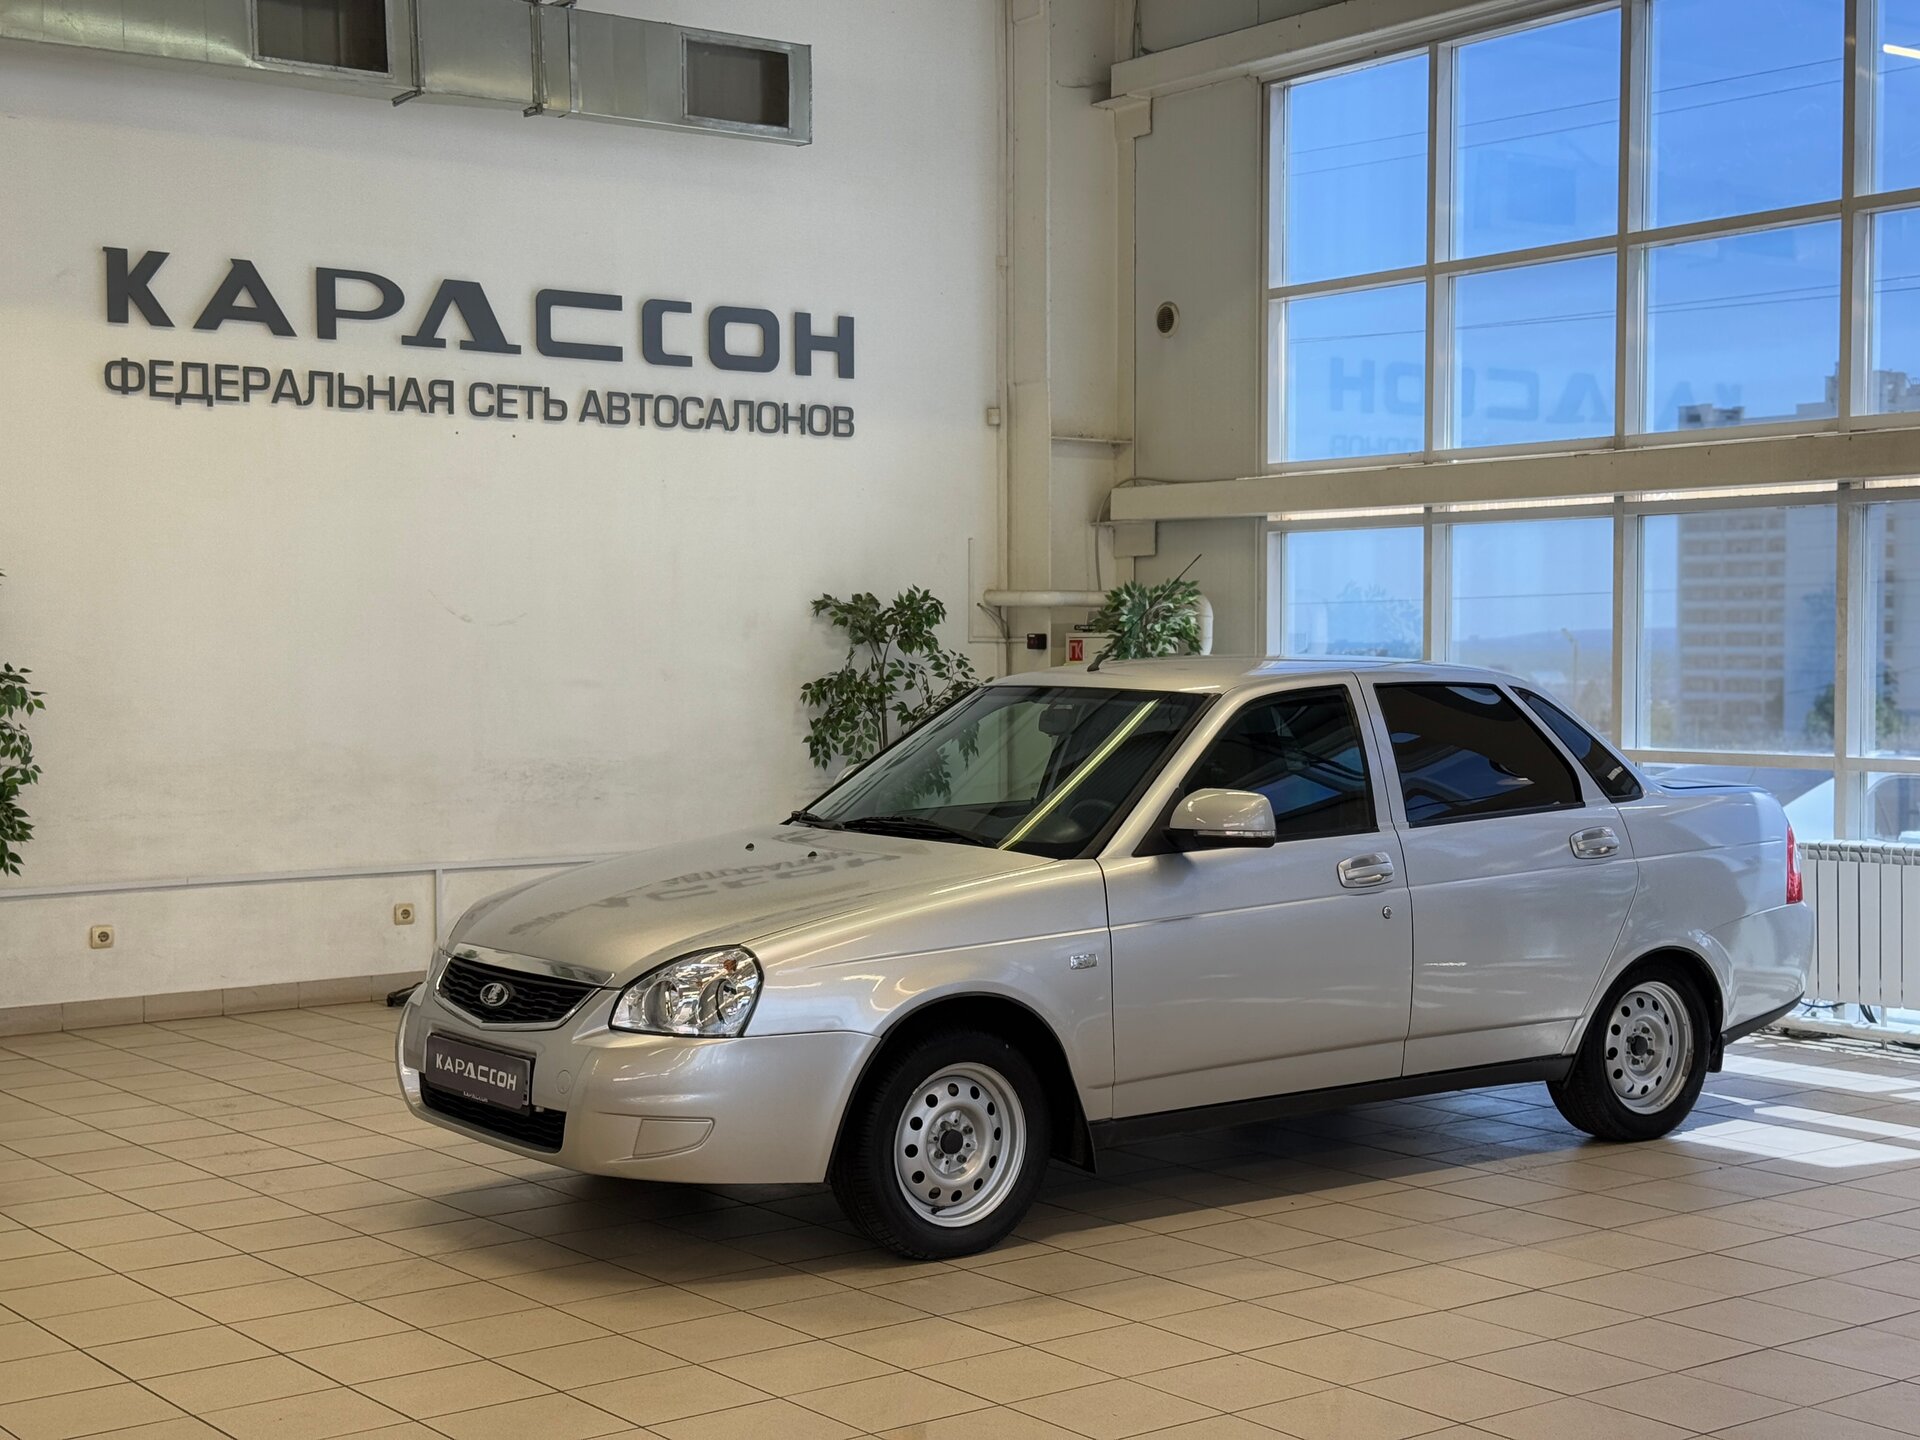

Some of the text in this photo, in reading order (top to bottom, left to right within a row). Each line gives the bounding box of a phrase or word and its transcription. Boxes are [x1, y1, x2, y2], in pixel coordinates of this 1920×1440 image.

[102, 246, 855, 379] КАРАССОН
[104, 357, 855, 438] ФЕДЕРАЛЬНАЯ СЕТЬ АВТОСАЛОНОВ
[1070, 642, 1083, 659] ПК
[436, 1053, 517, 1091] КАРАССОН
